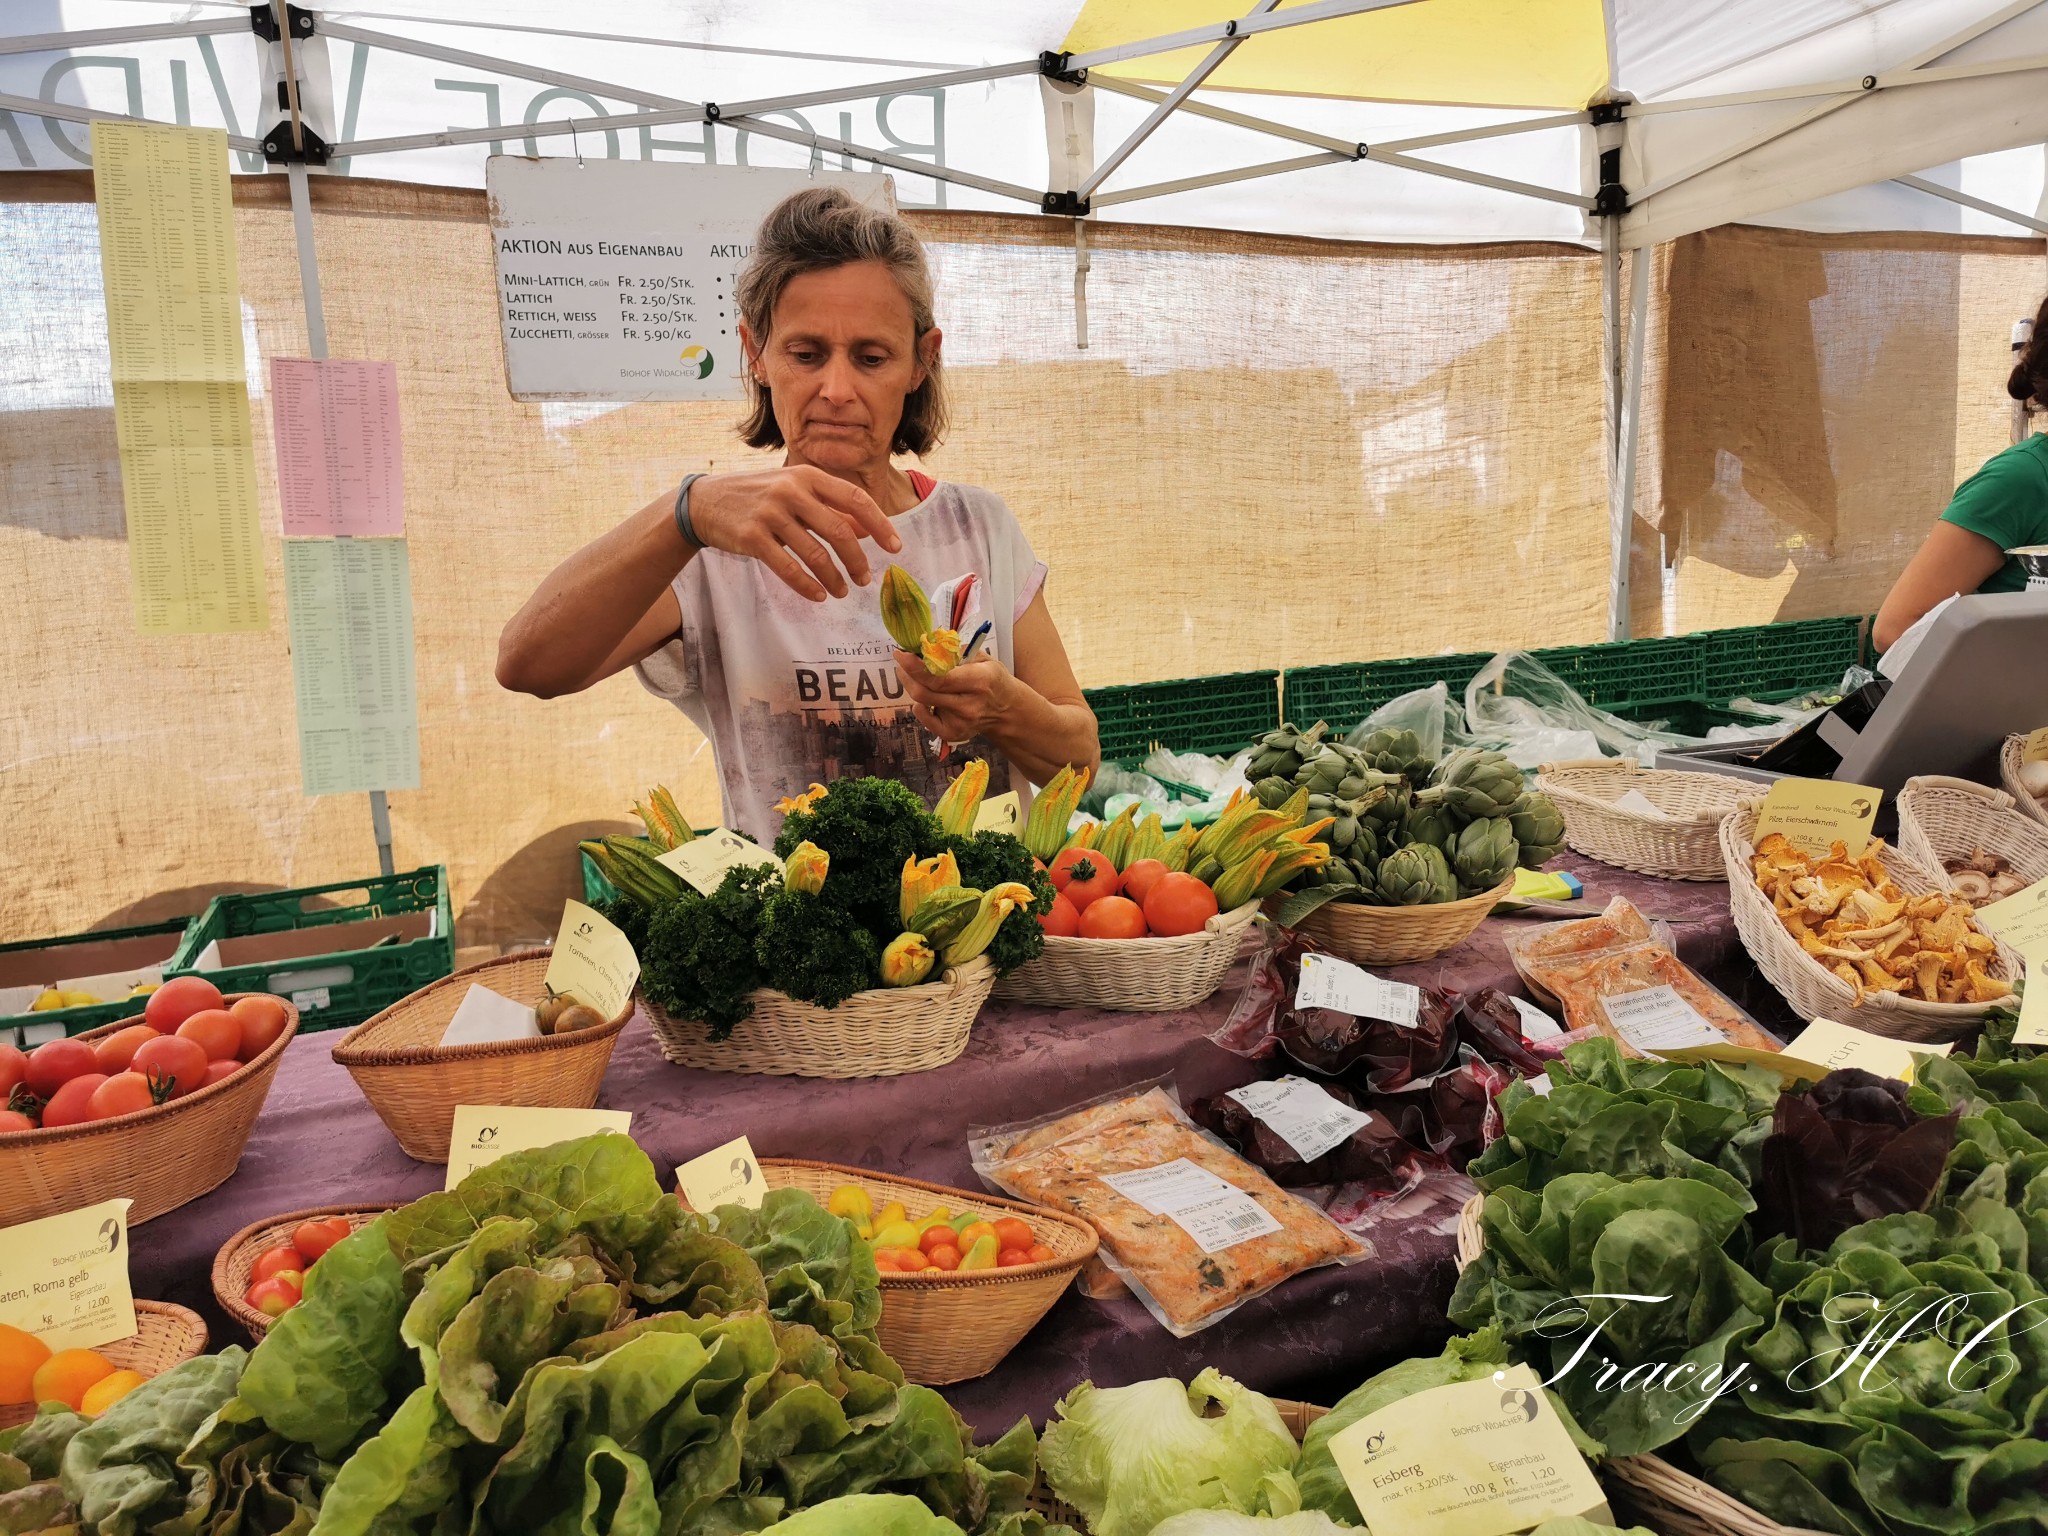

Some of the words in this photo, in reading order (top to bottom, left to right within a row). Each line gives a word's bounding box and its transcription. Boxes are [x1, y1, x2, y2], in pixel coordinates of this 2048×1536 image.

[501, 238, 562, 255] AKTION
[567, 244, 593, 255] AUS
[598, 241, 683, 258] EIGENANBAU
[506, 292, 553, 304] LATTICH
[508, 310, 560, 323] RETTICH,
[563, 311, 597, 323] WEISS
[509, 327, 575, 340] ZUCCHETTI,
[620, 368, 651, 379] BIOHOF
[653, 368, 695, 379] WIDACHER
[827, 647, 882, 656] BELIEVE
[796, 667, 904, 702] BEAU
[78, 1245, 109, 1261] WIDACHER
[0, 1288, 29, 1304] aten,
[33, 1279, 65, 1295] Roma
[69, 1270, 90, 1288] gelb
[70, 1282, 107, 1301] Eigenanbau
[42, 1314, 53, 1325] kg
[87, 1295, 110, 1310] 12.00
[1451, 1423, 1481, 1437] BIOHOF
[1482, 1414, 1524, 1431] WIDACHER
[1372, 1462, 1424, 1489] Eisberg
[1489, 1452, 1546, 1473] Eigenanbau
[1381, 1489, 1402, 1504] max.
[1403, 1484, 1417, 1496] Fr.
[1417, 1472, 1459, 1493] 3.20/Stk.
[1462, 1482, 1486, 1497] 100
[1488, 1481, 1497, 1493] g
[1503, 1475, 1518, 1487] Fr.
[1531, 1466, 1556, 1480] 1.20
